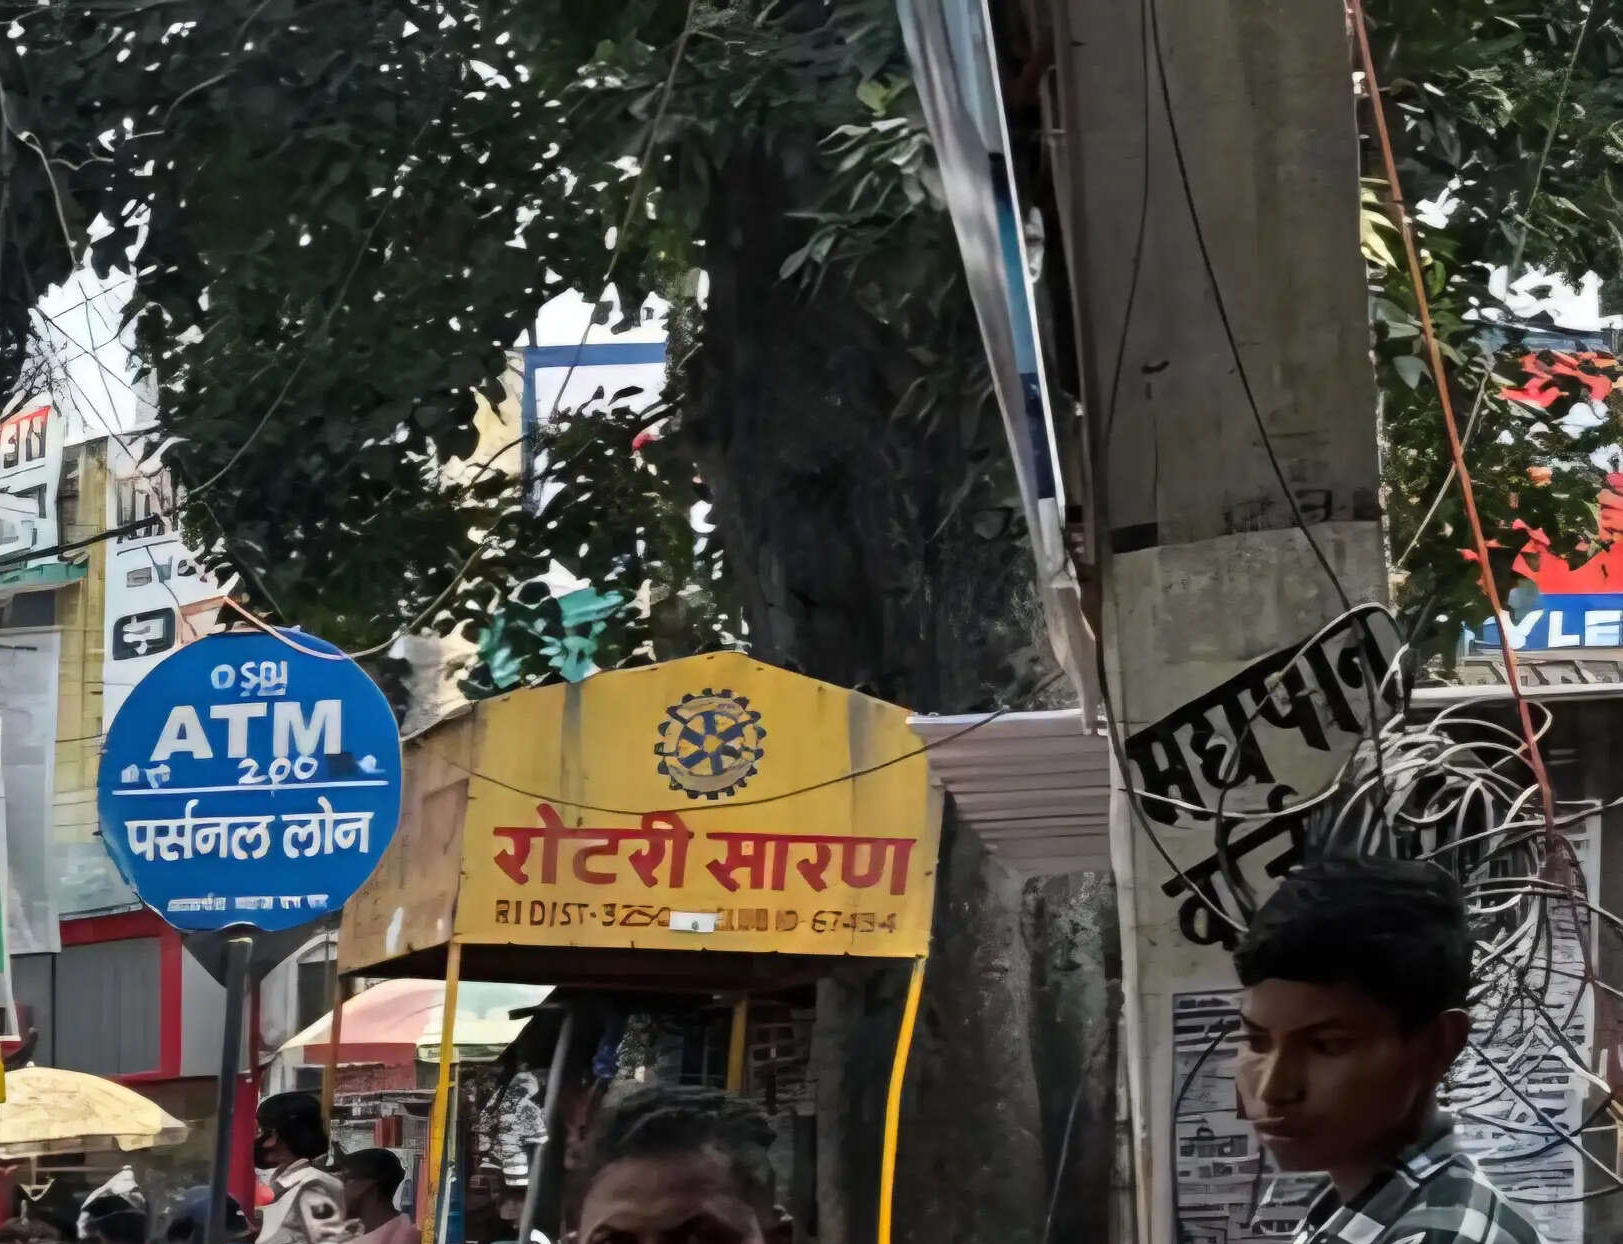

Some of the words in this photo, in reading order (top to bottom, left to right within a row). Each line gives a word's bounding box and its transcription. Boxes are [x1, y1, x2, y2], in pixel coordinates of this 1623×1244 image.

[149, 699, 342, 762] ATM
[124, 799, 276, 861] पर्सनल
[281, 796, 374, 860] लोन
[493, 803, 693, 889] रोटरी
[705, 831, 917, 896] सारण
